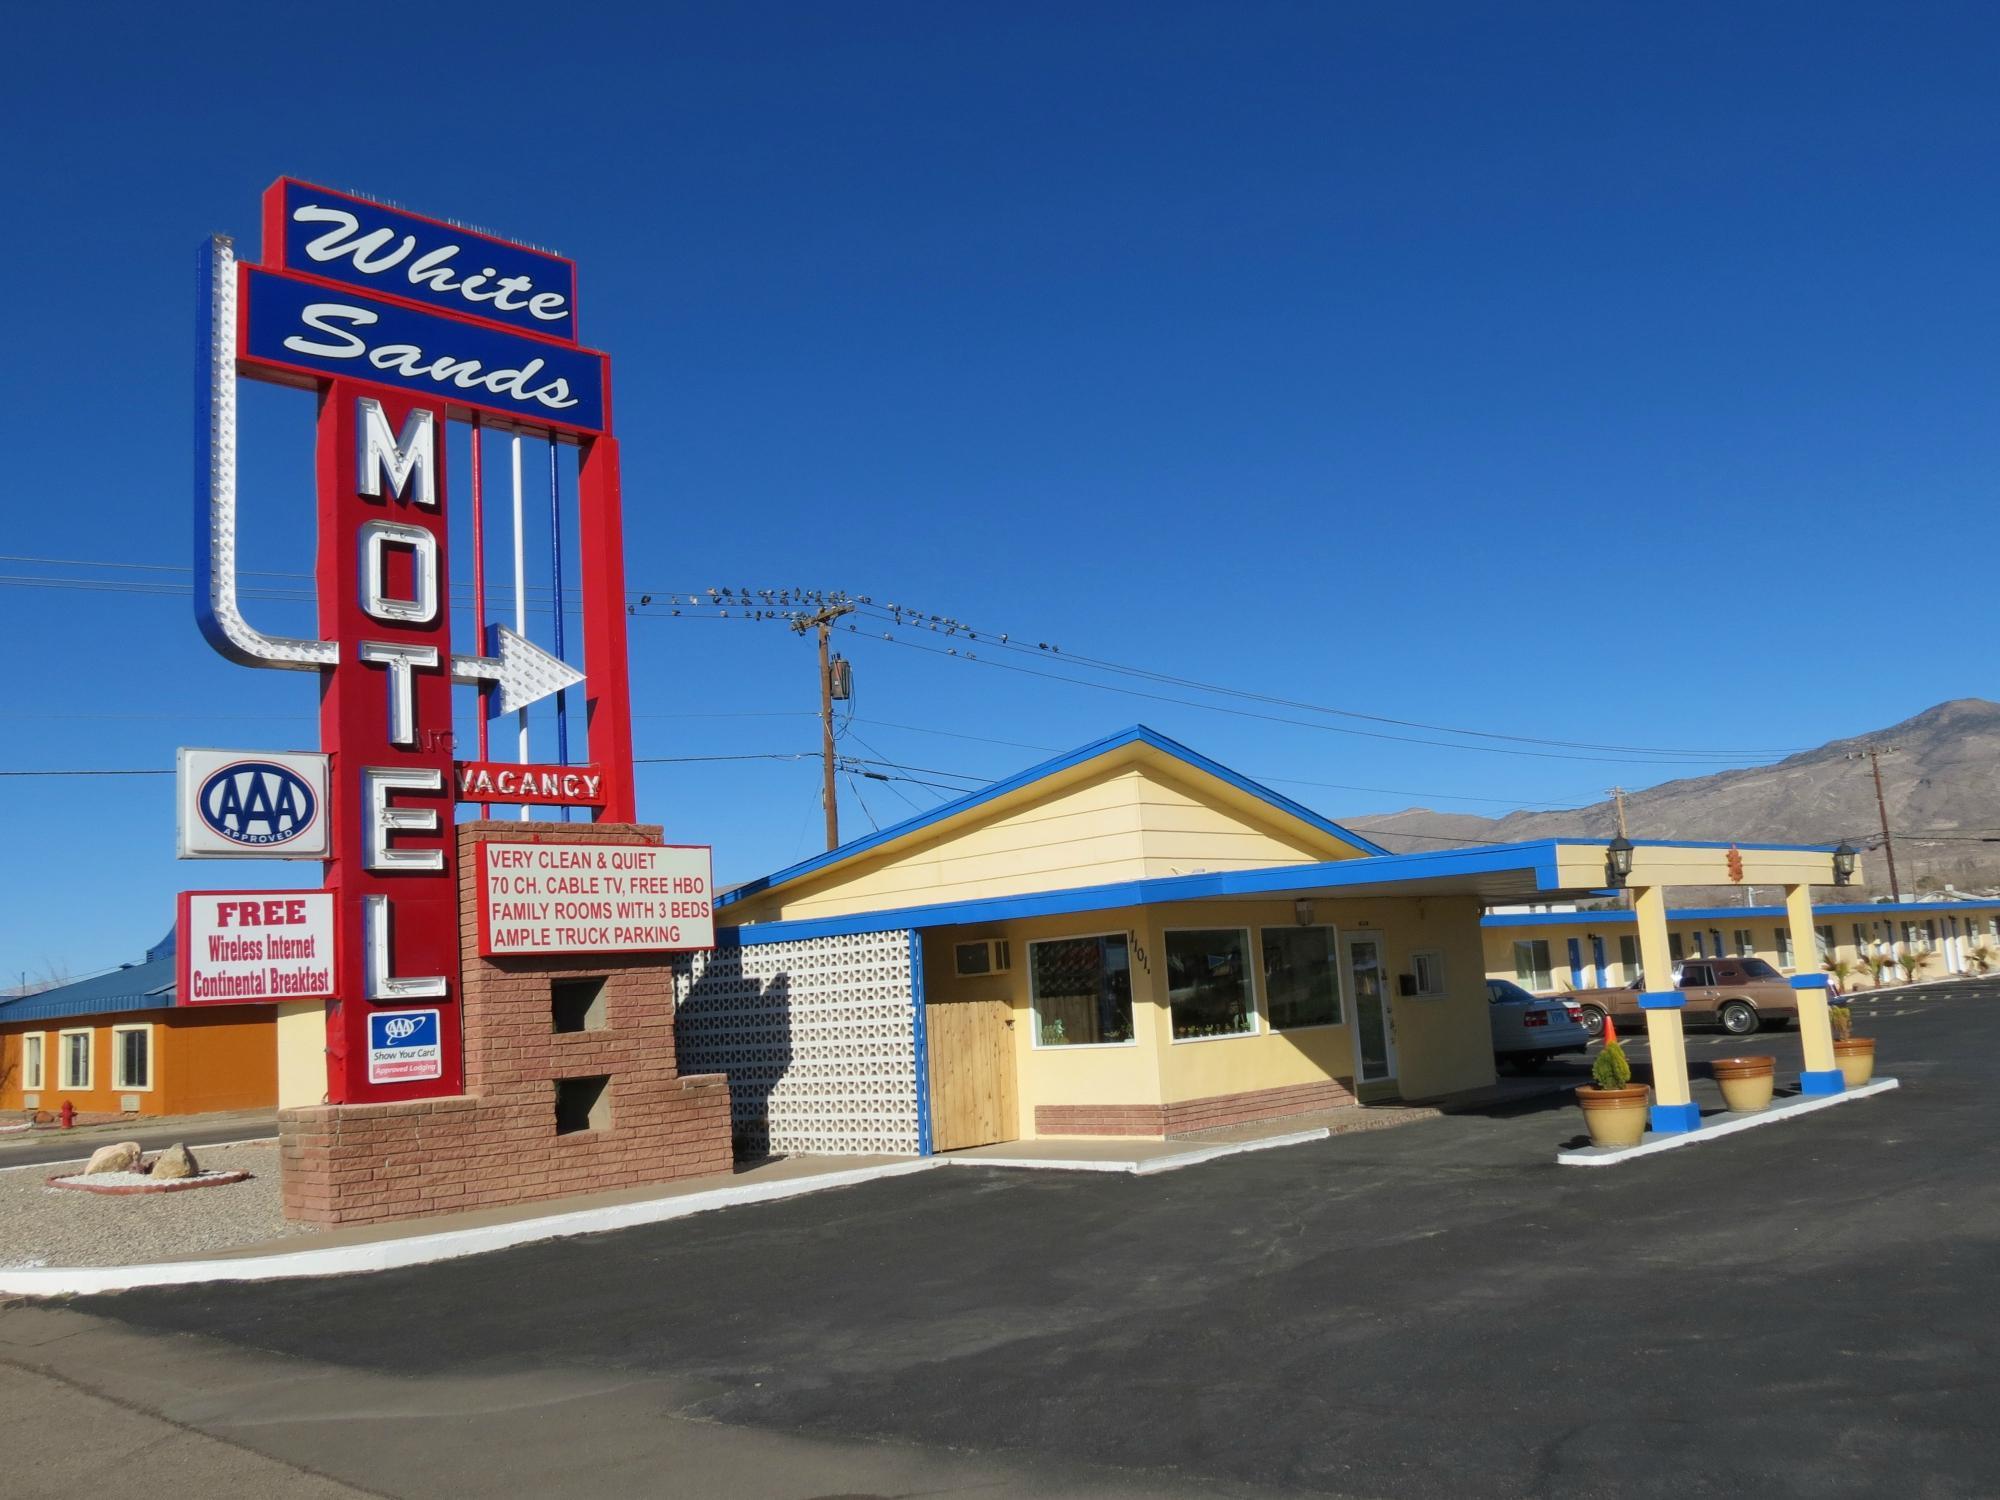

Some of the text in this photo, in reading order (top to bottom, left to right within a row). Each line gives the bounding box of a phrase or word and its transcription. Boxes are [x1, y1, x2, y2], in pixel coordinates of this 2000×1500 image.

[293, 204, 569, 321] White
[283, 303, 579, 409] Sands
[357, 396, 447, 999] MOTEL
[454, 769, 600, 798] VACANCY
[216, 771, 302, 834] AAA
[223, 828, 293, 843] APPROVED
[490, 850, 656, 870] VERY CLEAN & QUIET
[491, 876, 704, 897] 70 CH. CABLE TV, FREE HBO
[217, 899, 306, 928] FREE
[492, 901, 710, 921] FAMILY ROOMS WITH 3 BEDS
[208, 933, 315, 962] Wireless Internet
[494, 925, 680, 947] AMPLE TRUCK PARKING
[193, 966, 329, 998] Continental Breakfast
[374, 1048, 435, 1061] Show Your Card
